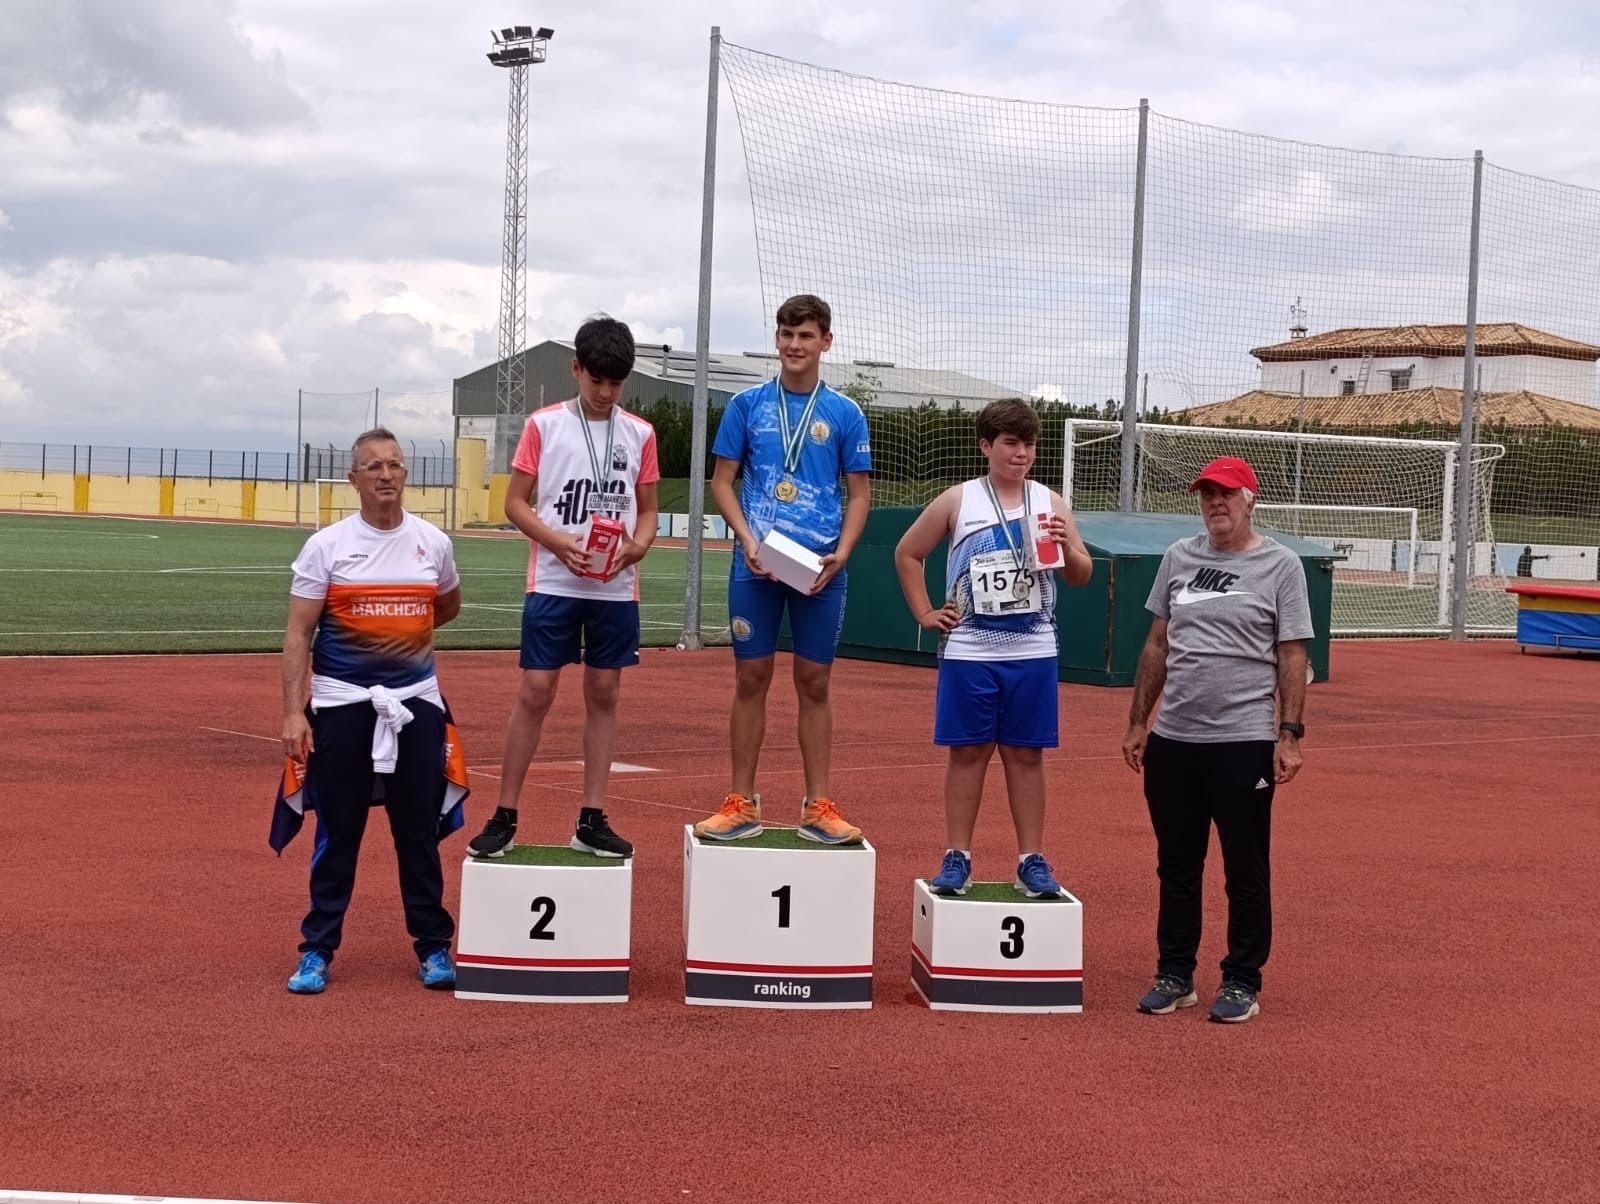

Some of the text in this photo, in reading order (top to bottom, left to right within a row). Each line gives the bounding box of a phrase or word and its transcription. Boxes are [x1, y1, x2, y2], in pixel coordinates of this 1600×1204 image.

[977, 568, 1035, 593] 1575
[1187, 567, 1240, 594] NIKE
[352, 603, 428, 616] MARCHENA
[529, 896, 556, 940] 2
[771, 885, 791, 928] 1
[1000, 916, 1025, 959] 3
[754, 981, 811, 999] ranking
